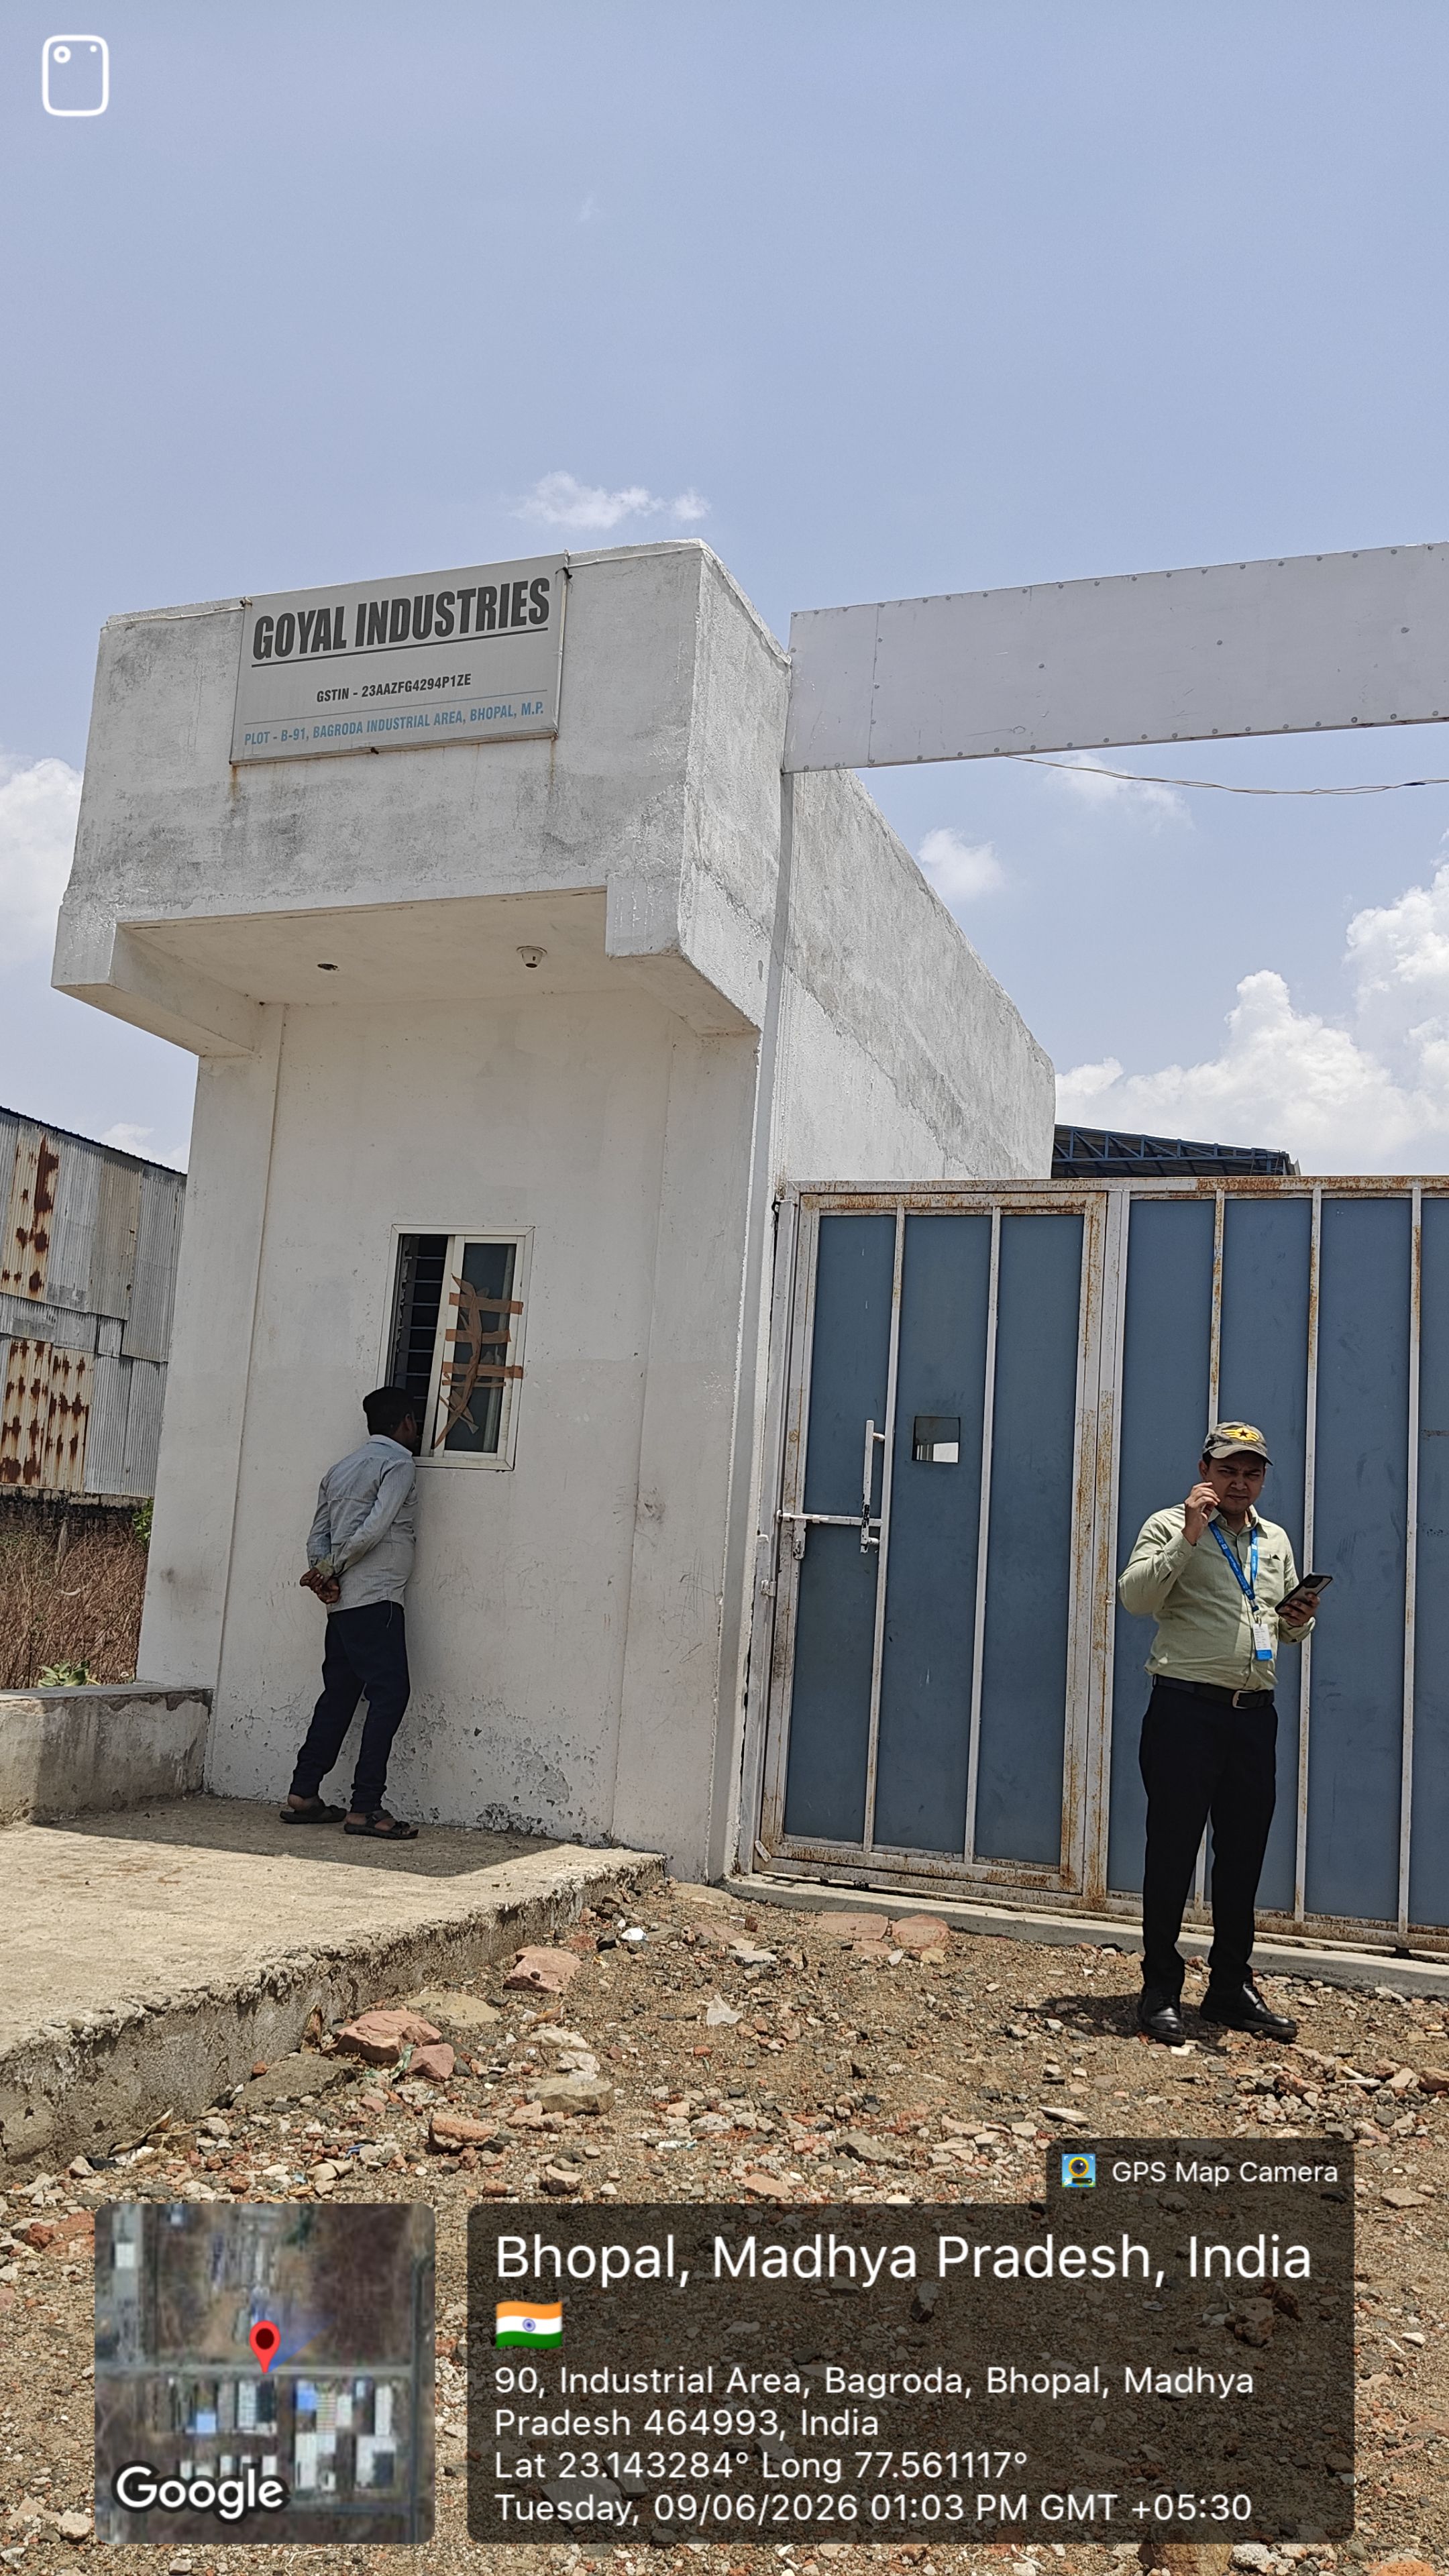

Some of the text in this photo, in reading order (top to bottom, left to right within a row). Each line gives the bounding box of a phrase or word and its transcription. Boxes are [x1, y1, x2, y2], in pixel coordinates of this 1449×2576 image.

[252, 577, 550, 660] GOYAL INDUSTRIES
[316, 688, 350, 703] GSTIN
[361, 673, 472, 698] 23AAZFG4294P1ZE
[244, 731, 270, 746] PLOT
[281, 728, 310, 742] B-91,
[313, 721, 364, 739] BAGRODA
[366, 714, 431, 733] INDUSTRIAL
[433, 710, 466, 726] AREA,
[470, 704, 517, 722] BHOPAL,
[521, 701, 545, 716] M.P.
